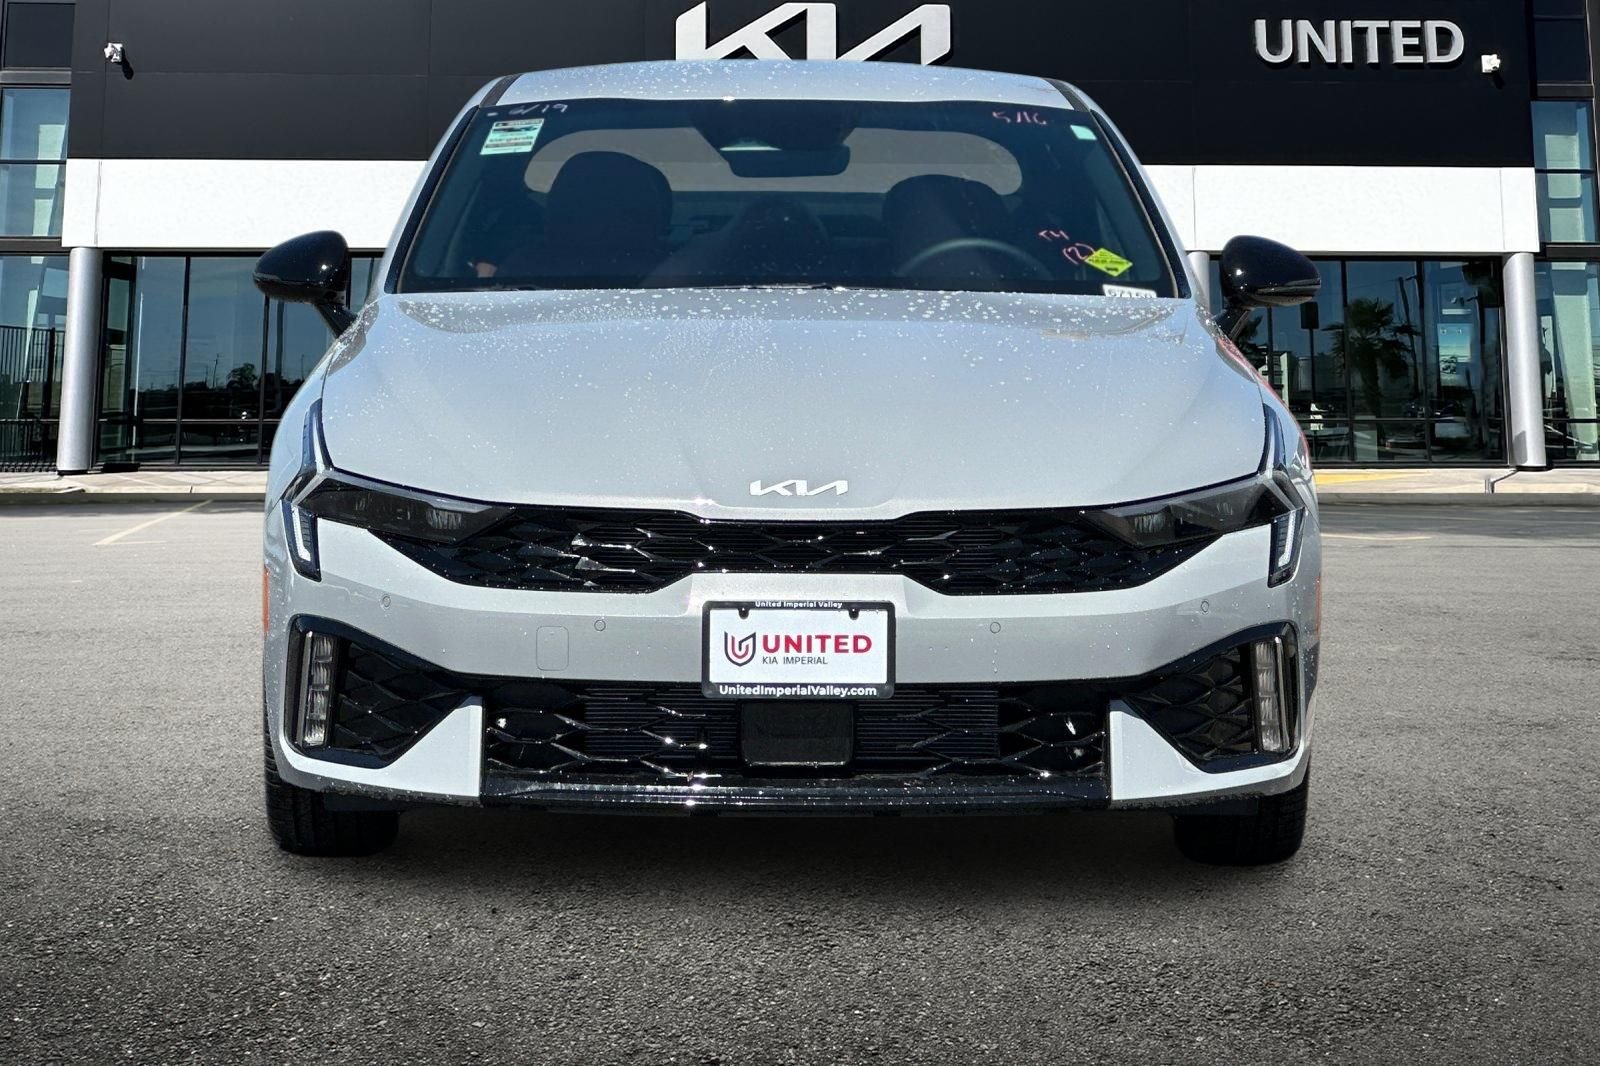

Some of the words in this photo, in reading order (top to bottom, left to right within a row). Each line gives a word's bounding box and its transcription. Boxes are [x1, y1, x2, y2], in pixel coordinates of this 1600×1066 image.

[676, 2, 950, 66] KIA
[1254, 19, 1465, 64] UNITED
[750, 479, 848, 496] KIA
[783, 601, 816, 609] Imperial
[818, 601, 843, 609] Valley
[762, 635, 872, 654] UNITED
[762, 656, 778, 665] KIA
[783, 656, 828, 665] IMPERIAL
[719, 685, 877, 697] UnitedImperialValley.com
